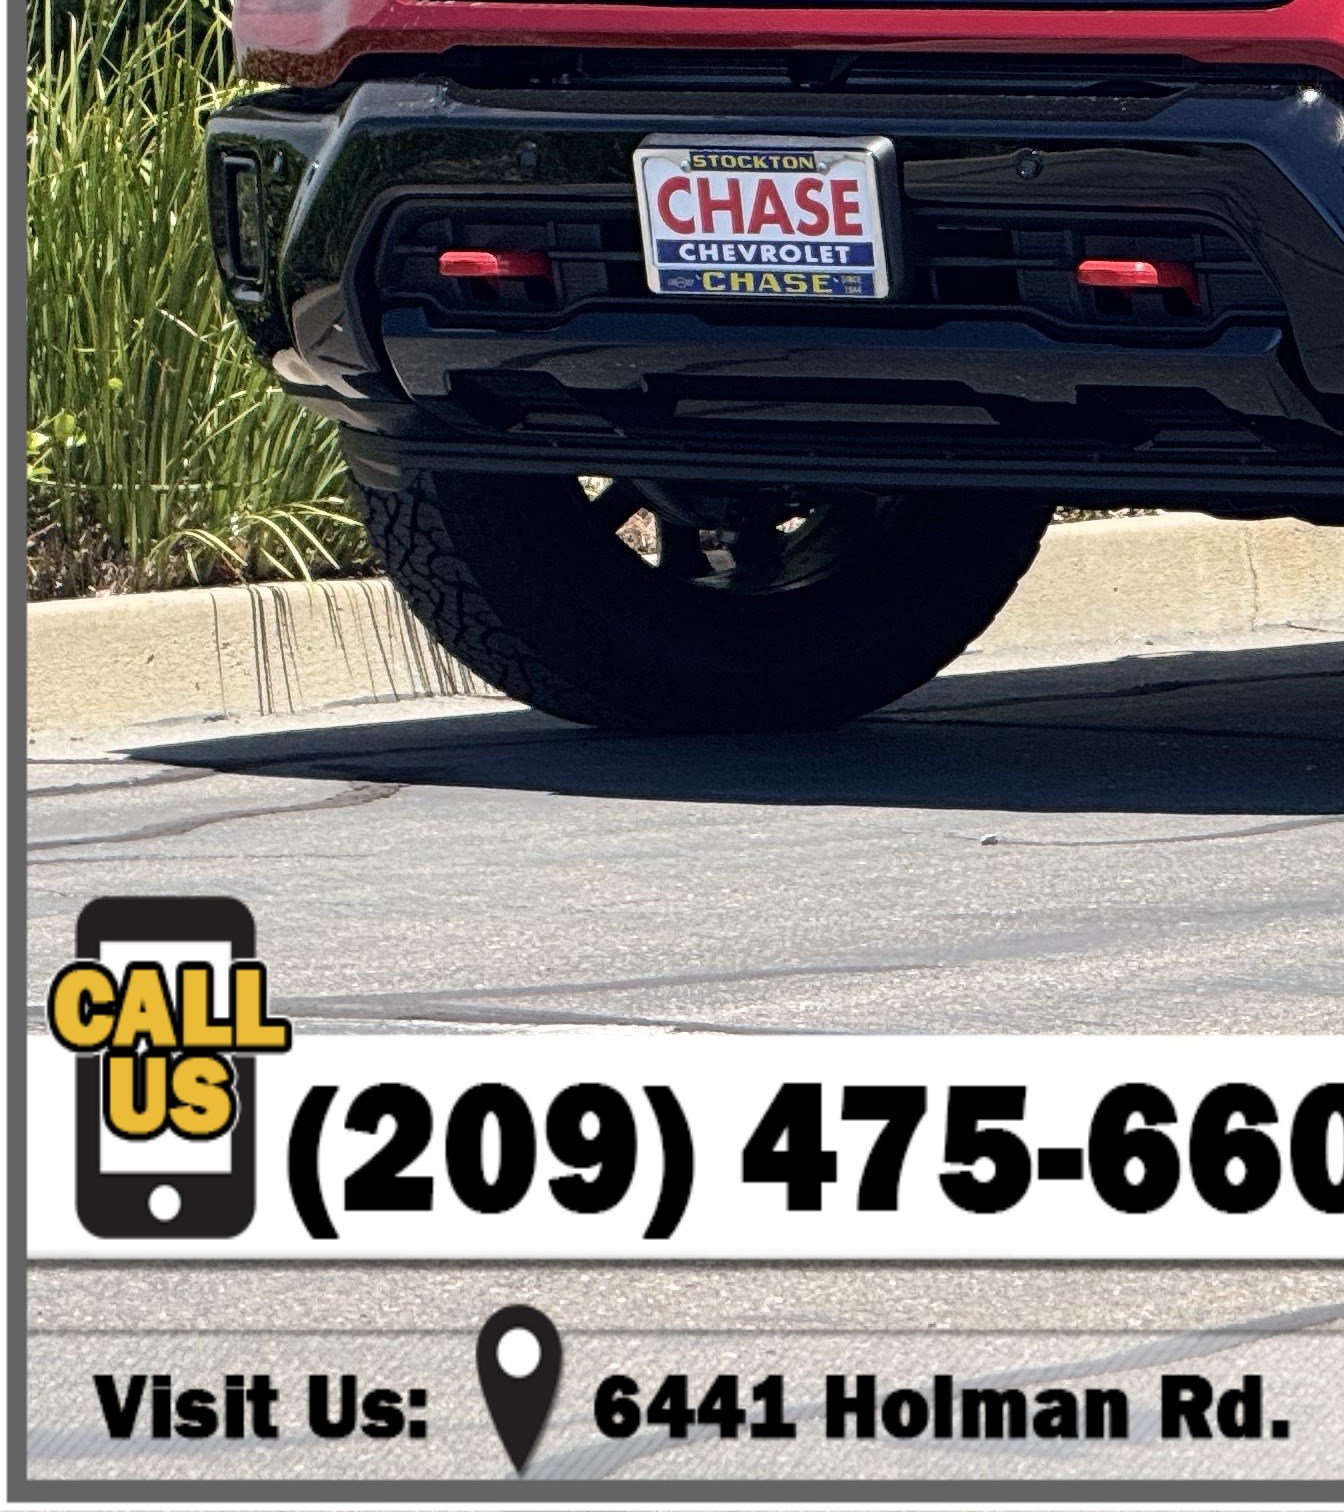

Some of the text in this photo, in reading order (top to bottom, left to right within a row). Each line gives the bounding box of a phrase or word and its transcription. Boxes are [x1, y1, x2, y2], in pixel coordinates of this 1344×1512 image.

[692, 154, 815, 171] STOCKTON
[656, 175, 864, 237] CHASE
[678, 242, 851, 264] CHEVROLET
[702, 270, 834, 295] CHASE
